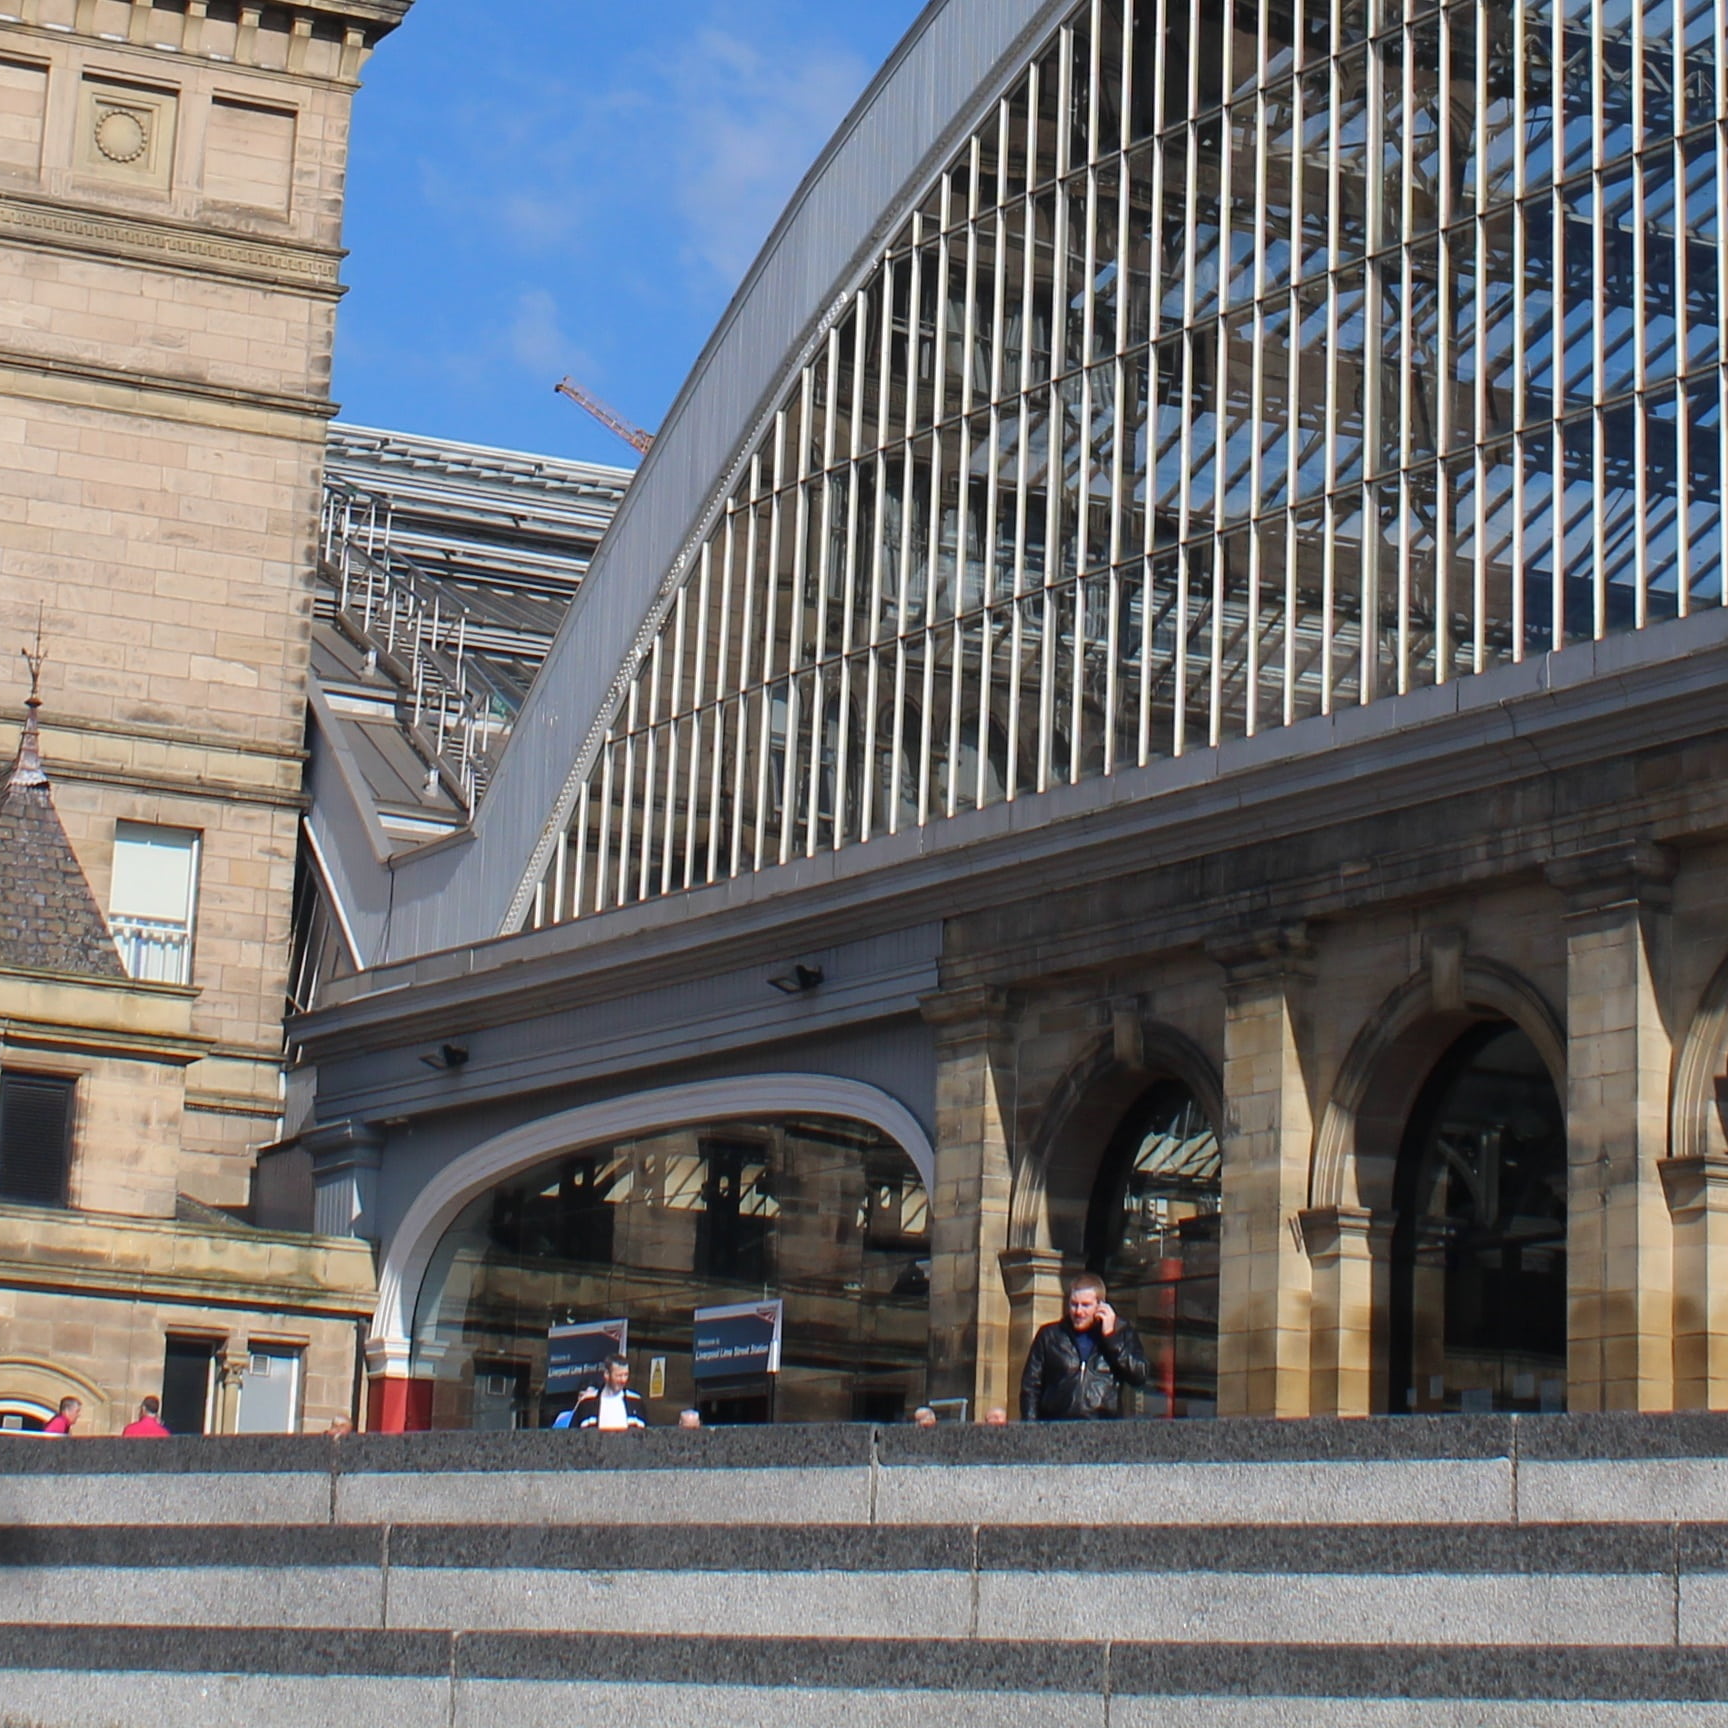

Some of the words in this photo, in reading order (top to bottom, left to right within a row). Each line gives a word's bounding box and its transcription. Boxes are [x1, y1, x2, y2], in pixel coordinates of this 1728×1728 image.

[695, 1349, 720, 1361] Liverpool
[720, 1347, 733, 1358] Lime
[734, 1344, 750, 1357] Street
[751, 1342, 769, 1355] Station
[548, 1365, 570, 1378] Liverpool
[570, 1363, 582, 1375] Lime
